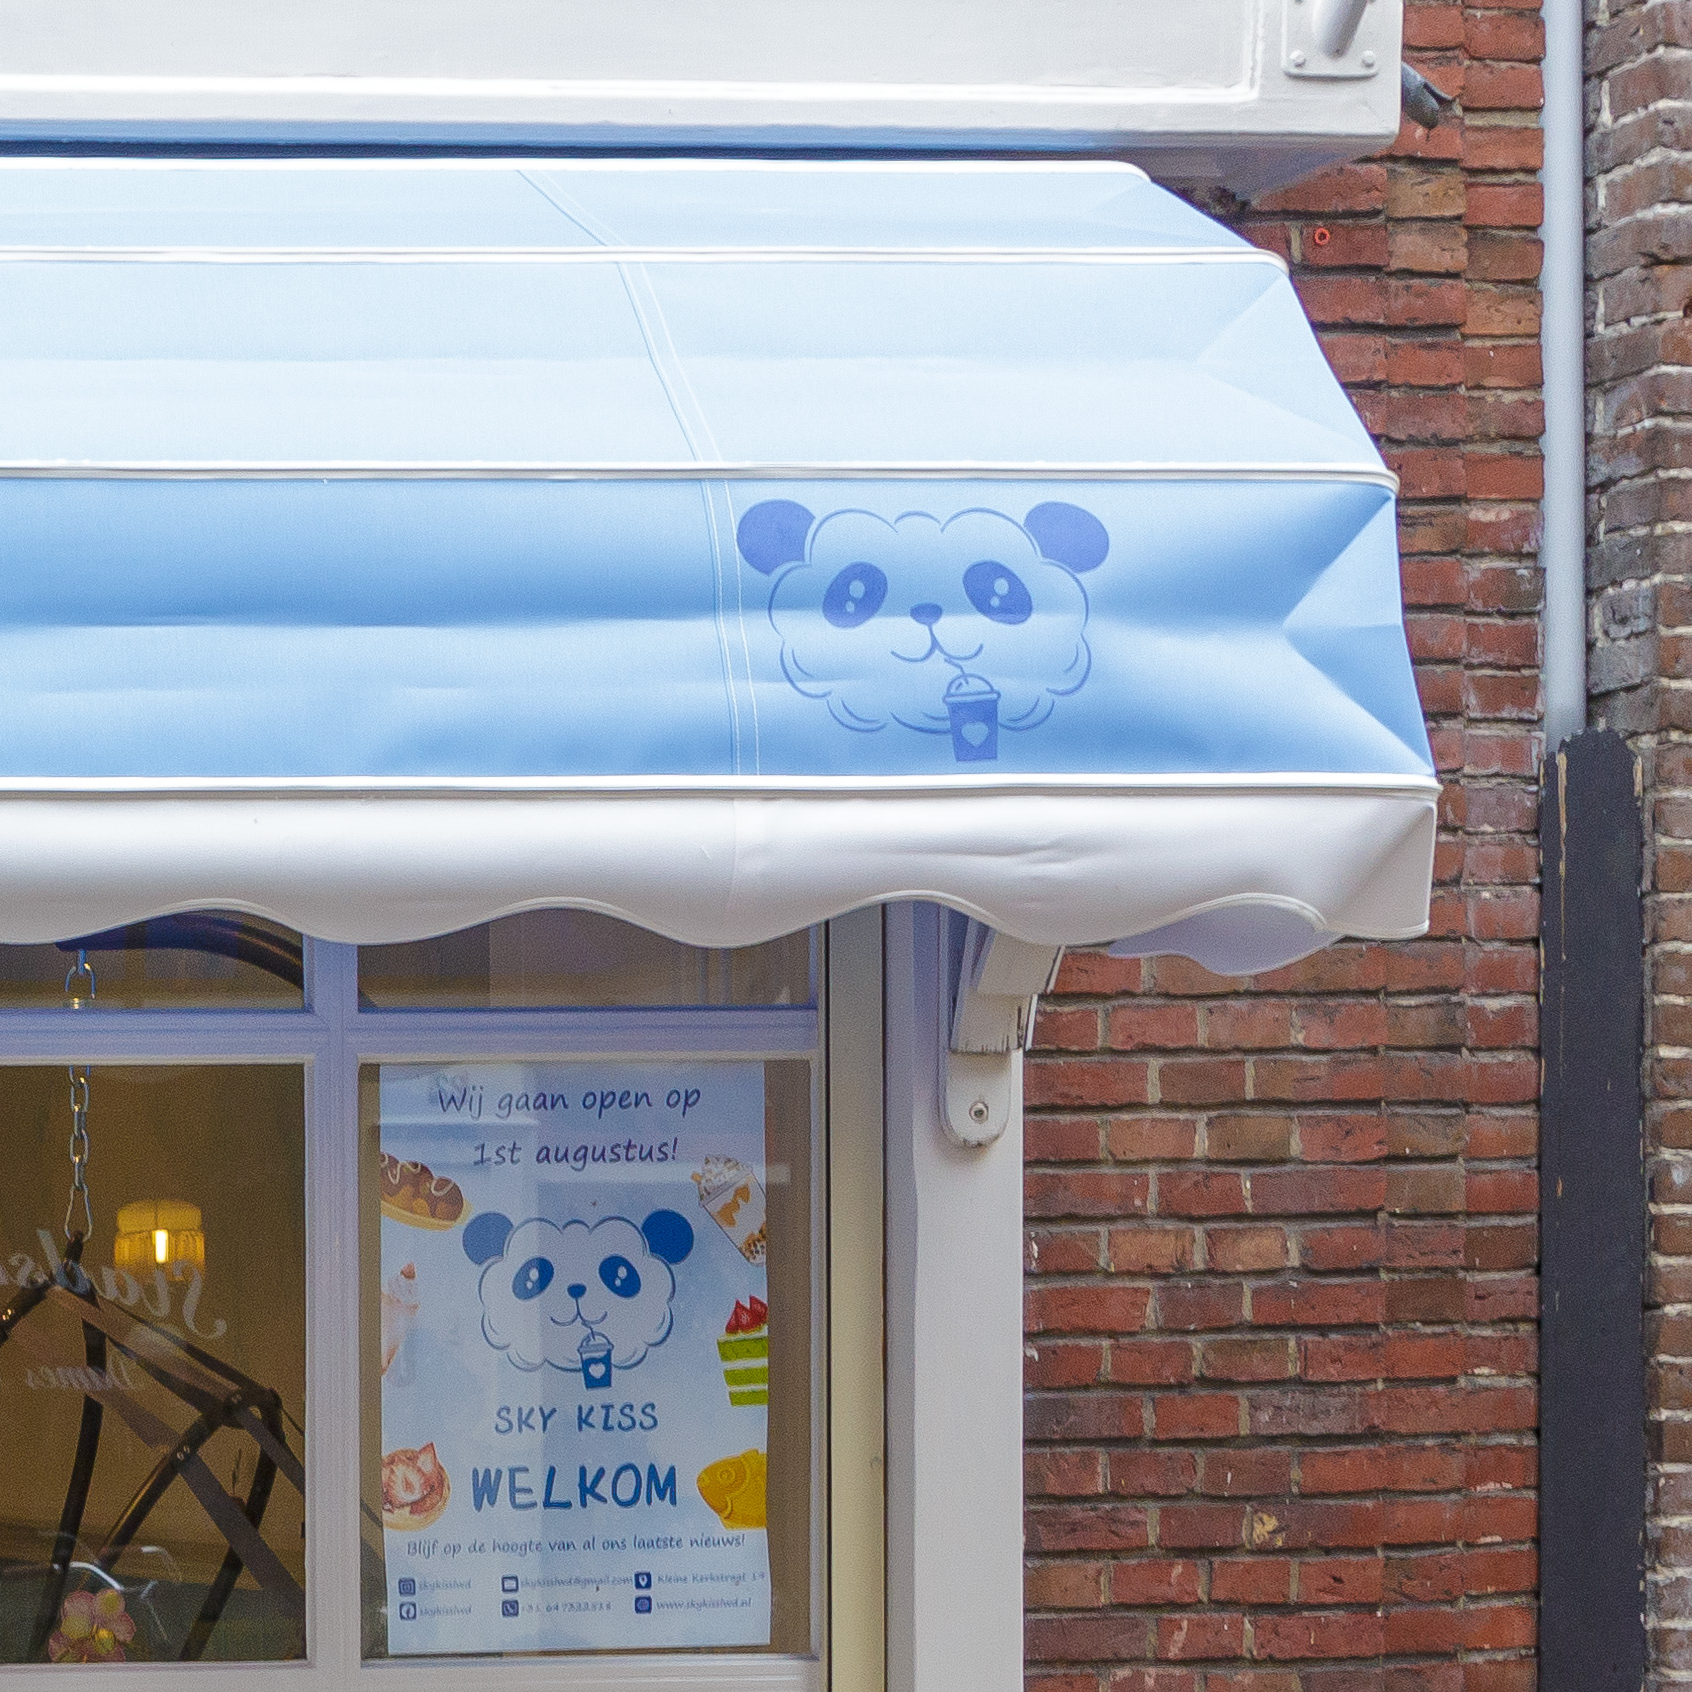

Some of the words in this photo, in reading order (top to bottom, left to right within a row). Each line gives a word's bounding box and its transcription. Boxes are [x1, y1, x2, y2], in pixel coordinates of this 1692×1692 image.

[437, 1086, 484, 1120] Wij
[497, 1091, 569, 1120] gaan
[582, 1087, 653, 1118] open
[666, 1087, 702, 1116] op
[472, 1141, 522, 1166] 1st
[535, 1137, 679, 1172] augustus!
[494, 1404, 557, 1434] SKY
[576, 1401, 660, 1432] KISS
[471, 1462, 678, 1513] WELKOM
[407, 1539, 439, 1560] Blijf
[443, 1542, 462, 1559] op
[467, 1539, 485, 1554] de
[492, 1538, 542, 1558] hoogte
[548, 1539, 576, 1551] van
[582, 1535, 596, 1551] al
[602, 1538, 627, 1551] ons
[633, 1533, 684, 1549] laatste
[689, 1532, 746, 1549] nieuws!
